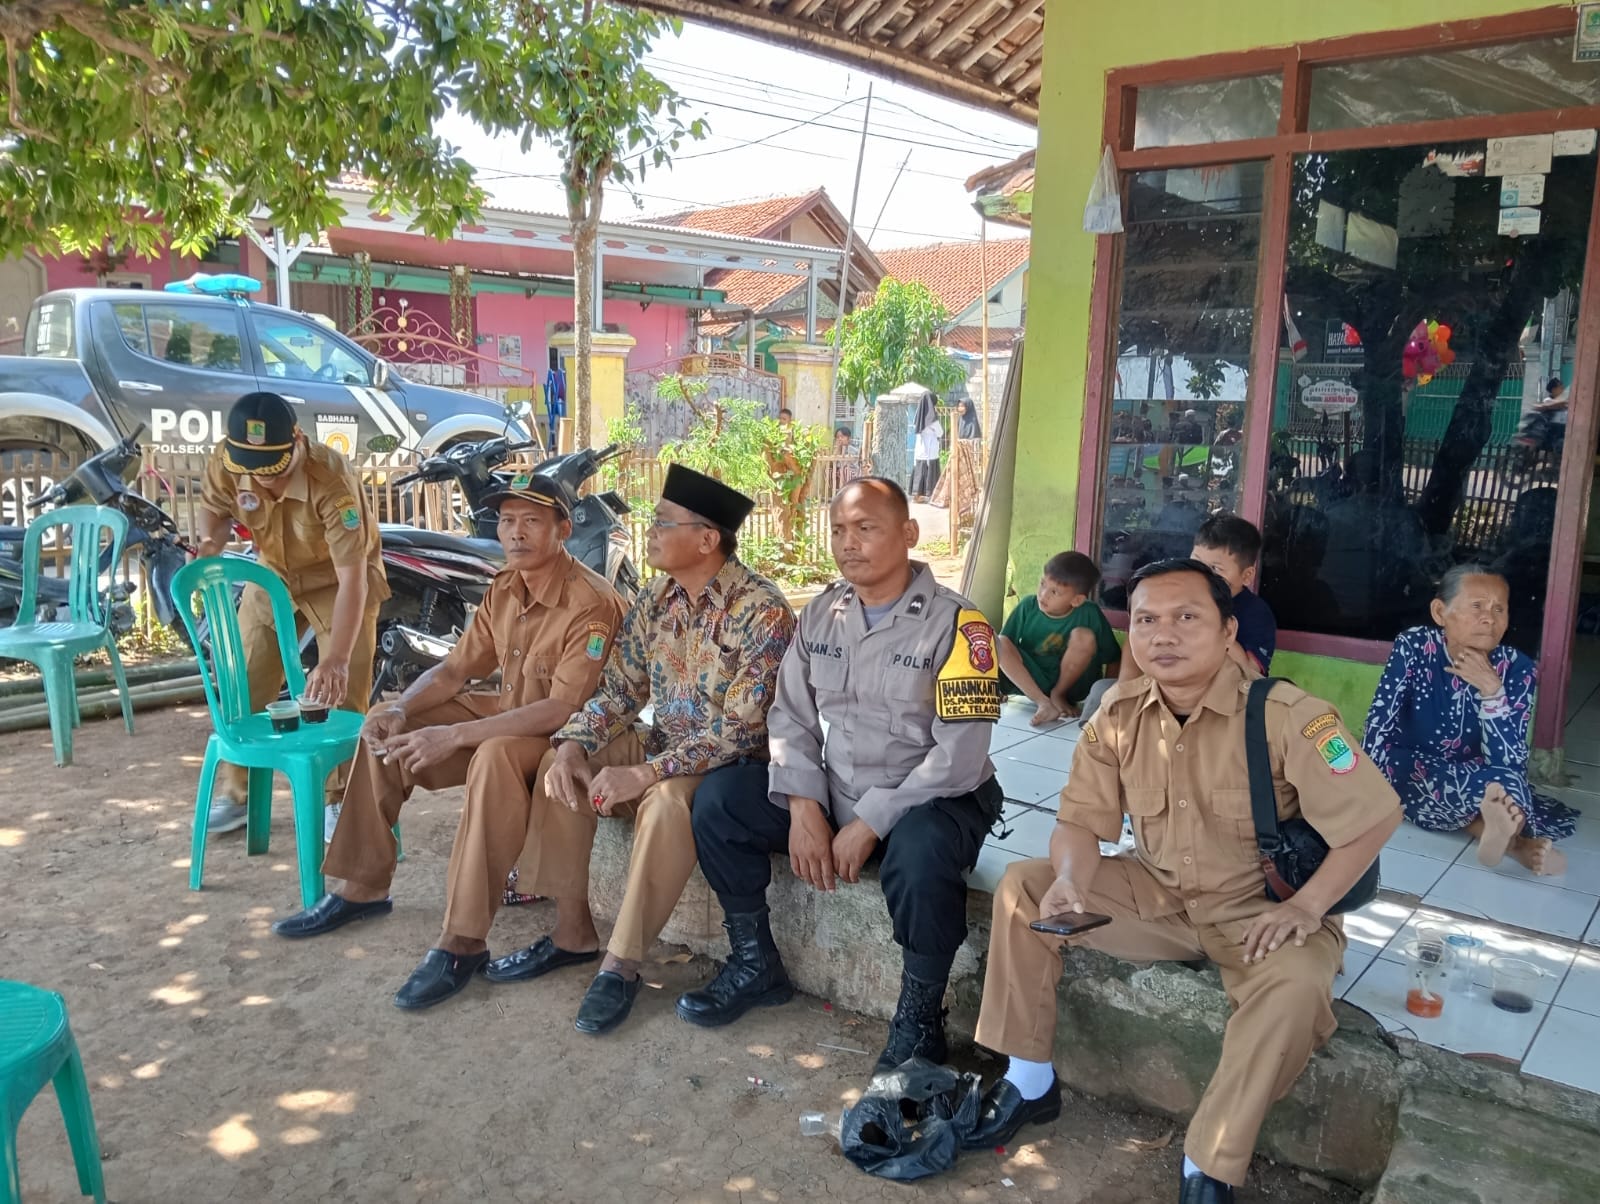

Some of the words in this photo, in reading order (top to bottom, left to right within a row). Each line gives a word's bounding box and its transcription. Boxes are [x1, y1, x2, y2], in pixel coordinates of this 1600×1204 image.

[151, 408, 227, 443] POL
[317, 414, 356, 423] SABHARA
[208, 445, 217, 454] T
[893, 654, 933, 670] POLR
[942, 680, 999, 697] BHABINKANT
